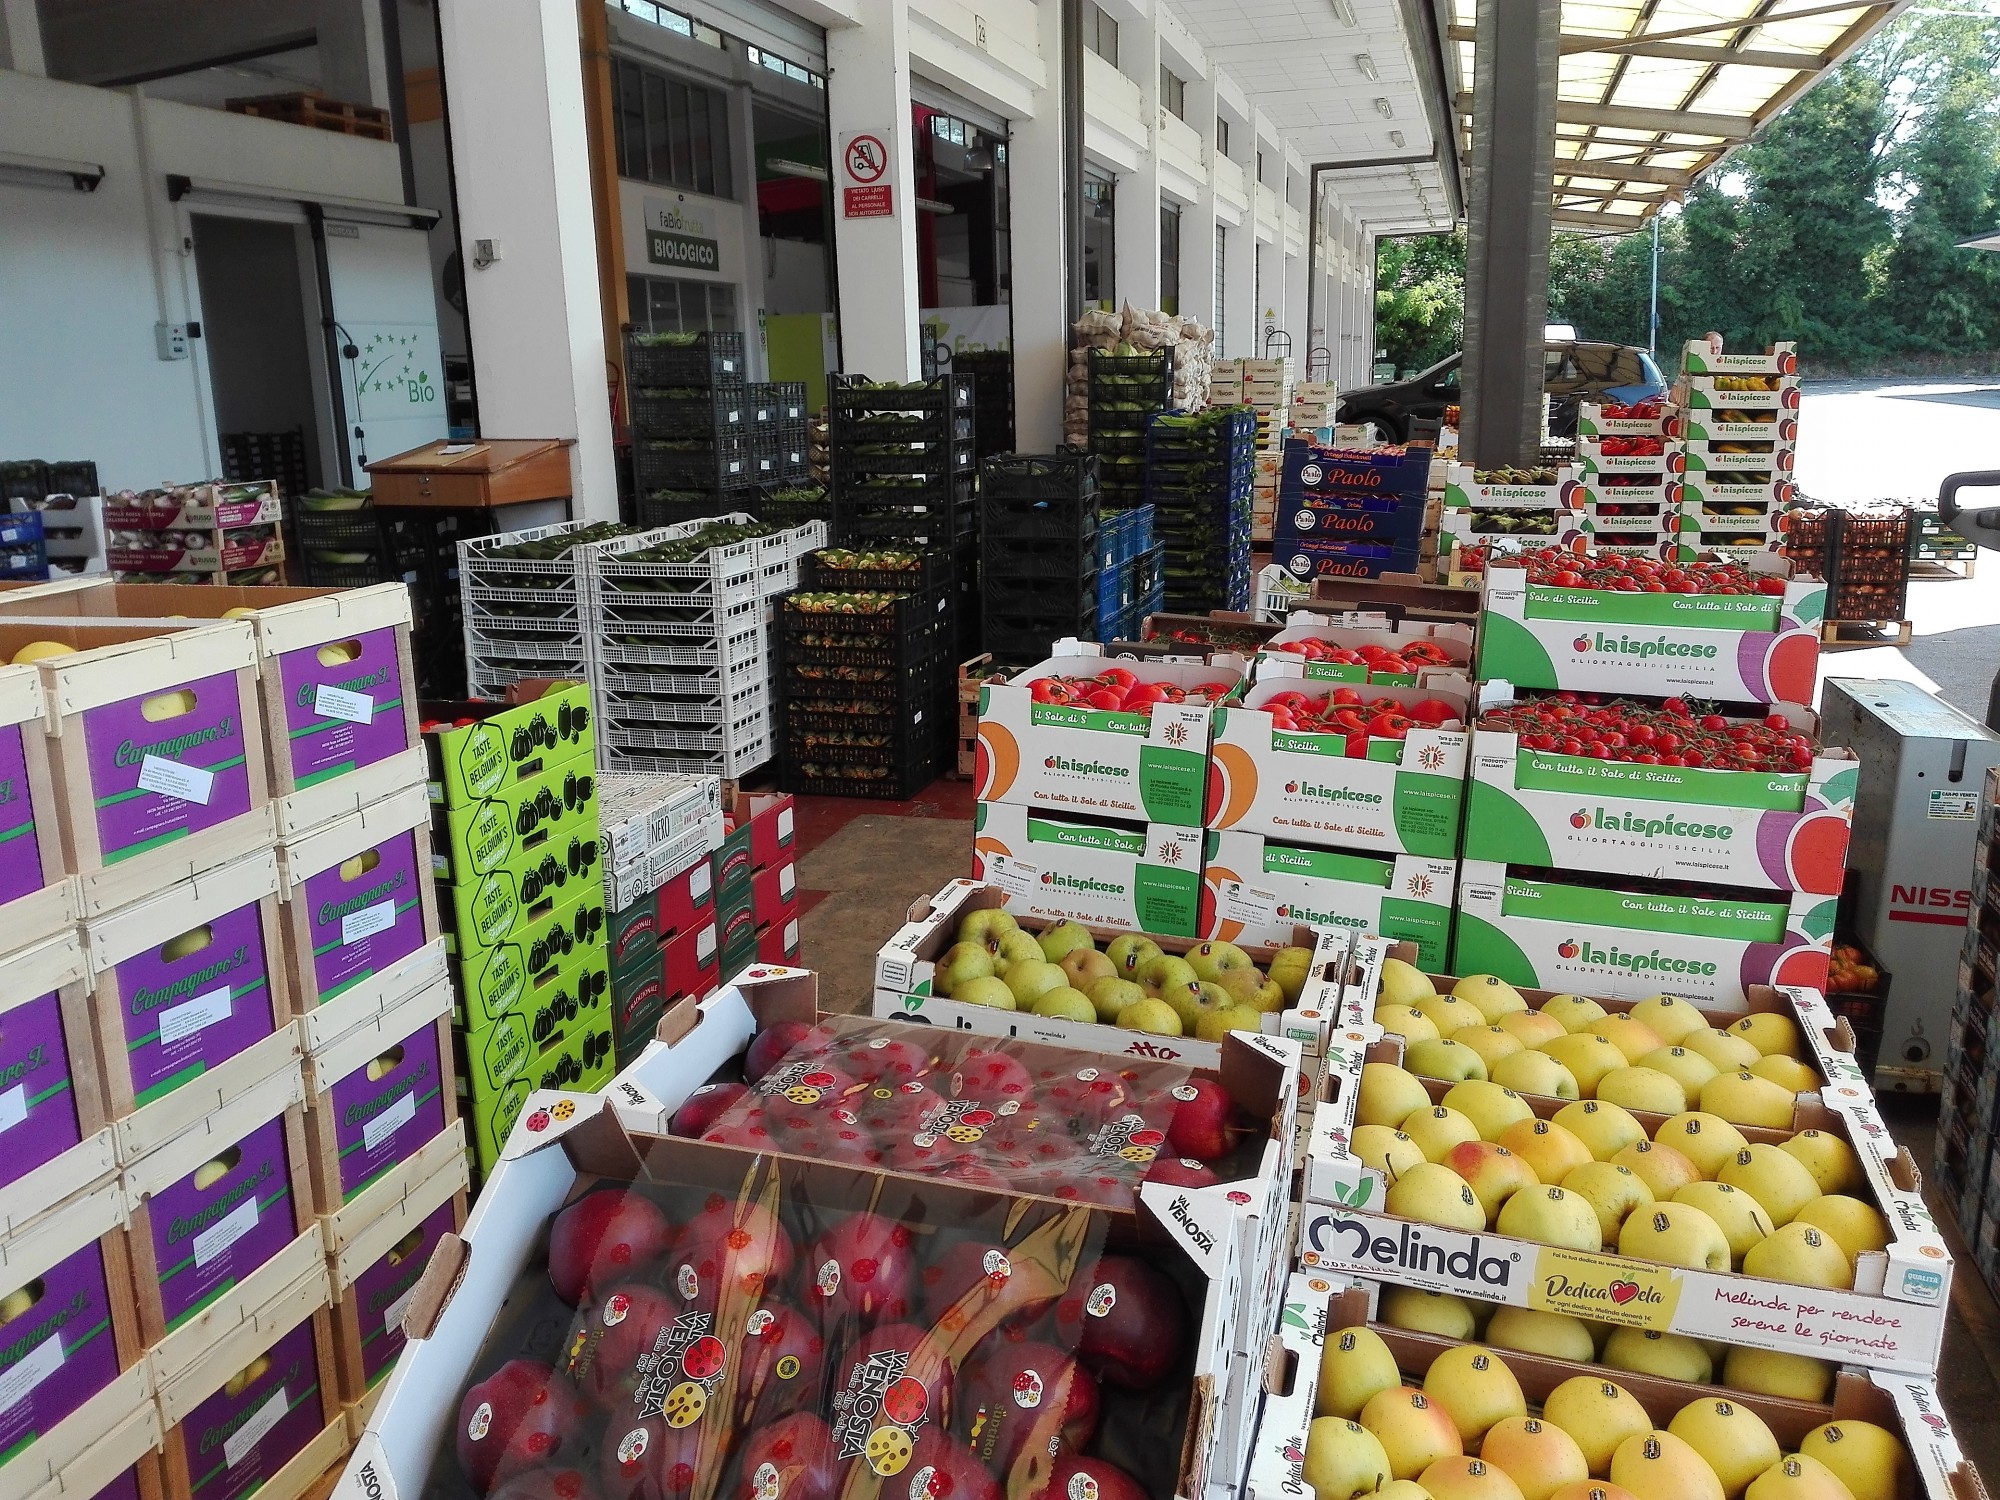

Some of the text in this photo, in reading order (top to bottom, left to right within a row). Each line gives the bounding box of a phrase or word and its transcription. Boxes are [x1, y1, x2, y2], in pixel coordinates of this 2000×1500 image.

[859, 208, 890, 216] AUTORIZZATO
[654, 238, 714, 265] BIOLOGICO
[407, 379, 434, 402] Bio
[1328, 468, 1381, 487] Paolo
[1321, 513, 1374, 532] Paolo
[1317, 558, 1369, 577] Paolo
[1529, 591, 1600, 605] Sole di Sicilia
[1672, 600, 1693, 611] Con
[1695, 600, 1720, 611] tutto
[1723, 602, 1733, 611] il
[1735, 601, 1758, 613] Sole
[1760, 603, 1772, 613] di
[1316, 667, 1344, 678] Sicilia
[1666, 677, 1714, 686] www.laispicese.it
[472, 737, 492, 761] TASTE
[1273, 739, 1321, 752] di Sicilia
[469, 750, 503, 787] BELGIUM'S
[1147, 762, 1196, 774] www.laispicese.it
[1531, 759, 1683, 785] Con tutto il Sole di Sicilia
[1033, 791, 1137, 811] Con tutto il Sole di Sicilia
[1403, 789, 1457, 800] www.laispicese.it
[478, 817, 498, 838] TASTE
[651, 815, 670, 845] NERO
[1272, 816, 1386, 837] Con tutto il Sole di Sicilia
[476, 825, 508, 863] BELGIUM'S
[1057, 831, 1147, 851] Con tutto il Sole di
[721, 853, 748, 875] TRADIZIONALE
[1265, 854, 1313, 867] di Sicilia
[1675, 860, 1730, 871] www.laispicese.it
[1142, 880, 1191, 892] www.laispicese.it
[1506, 885, 1542, 900] Sicilia
[484, 887, 503, 909] TASTE
[481, 895, 513, 935] BELGIUM'S
[1388, 914, 1442, 927] www.laispicese.it
[1621, 899, 1774, 922] Con tutto il Sole di Sicilia
[620, 918, 653, 946] TRADIZIONALE
[725, 911, 750, 935] TRADIZIONALE
[491, 957, 511, 982] TASTE
[488, 968, 520, 1007] BELGIUM'S
[1660, 990, 1715, 1002] www.laispicese.it
[627, 985, 659, 1014] TRADIZIONALE
[1033, 1029, 1067, 1040] www.melinda.it
[1252, 1036, 1287, 1059] VENOSTA
[763, 1062, 814, 1097] VENOSTA
[929, 1100, 969, 1137] VENOSTA
[1177, 1194, 1190, 1211] VAL
[1167, 1199, 1214, 1256] VENOSTA
[1578, 1256, 1597, 1265] dedica
[1453, 1286, 1507, 1302] www.melinda.it
[1544, 1274, 1609, 1299] Dedica
[1557, 1300, 1571, 1308] ogni
[1594, 1306, 1620, 1316] Melinda
[1621, 1311, 1643, 1320] donerà
[1561, 1307, 1594, 1319] terremotati
[1605, 1315, 1626, 1324] Centro
[1714, 1288, 1902, 1329] Melinda per rendere
[684, 1311, 711, 1344] VAL
[1311, 1307, 1327, 1347] Melinda
[1731, 1315, 1899, 1352] serene le giornate
[634, 1326, 671, 1404] Mela Alto Adige
[638, 1311, 699, 1420] VENOSTA
[889, 1351, 910, 1386] VAL
[838, 1349, 895, 1461] VENOSTA
